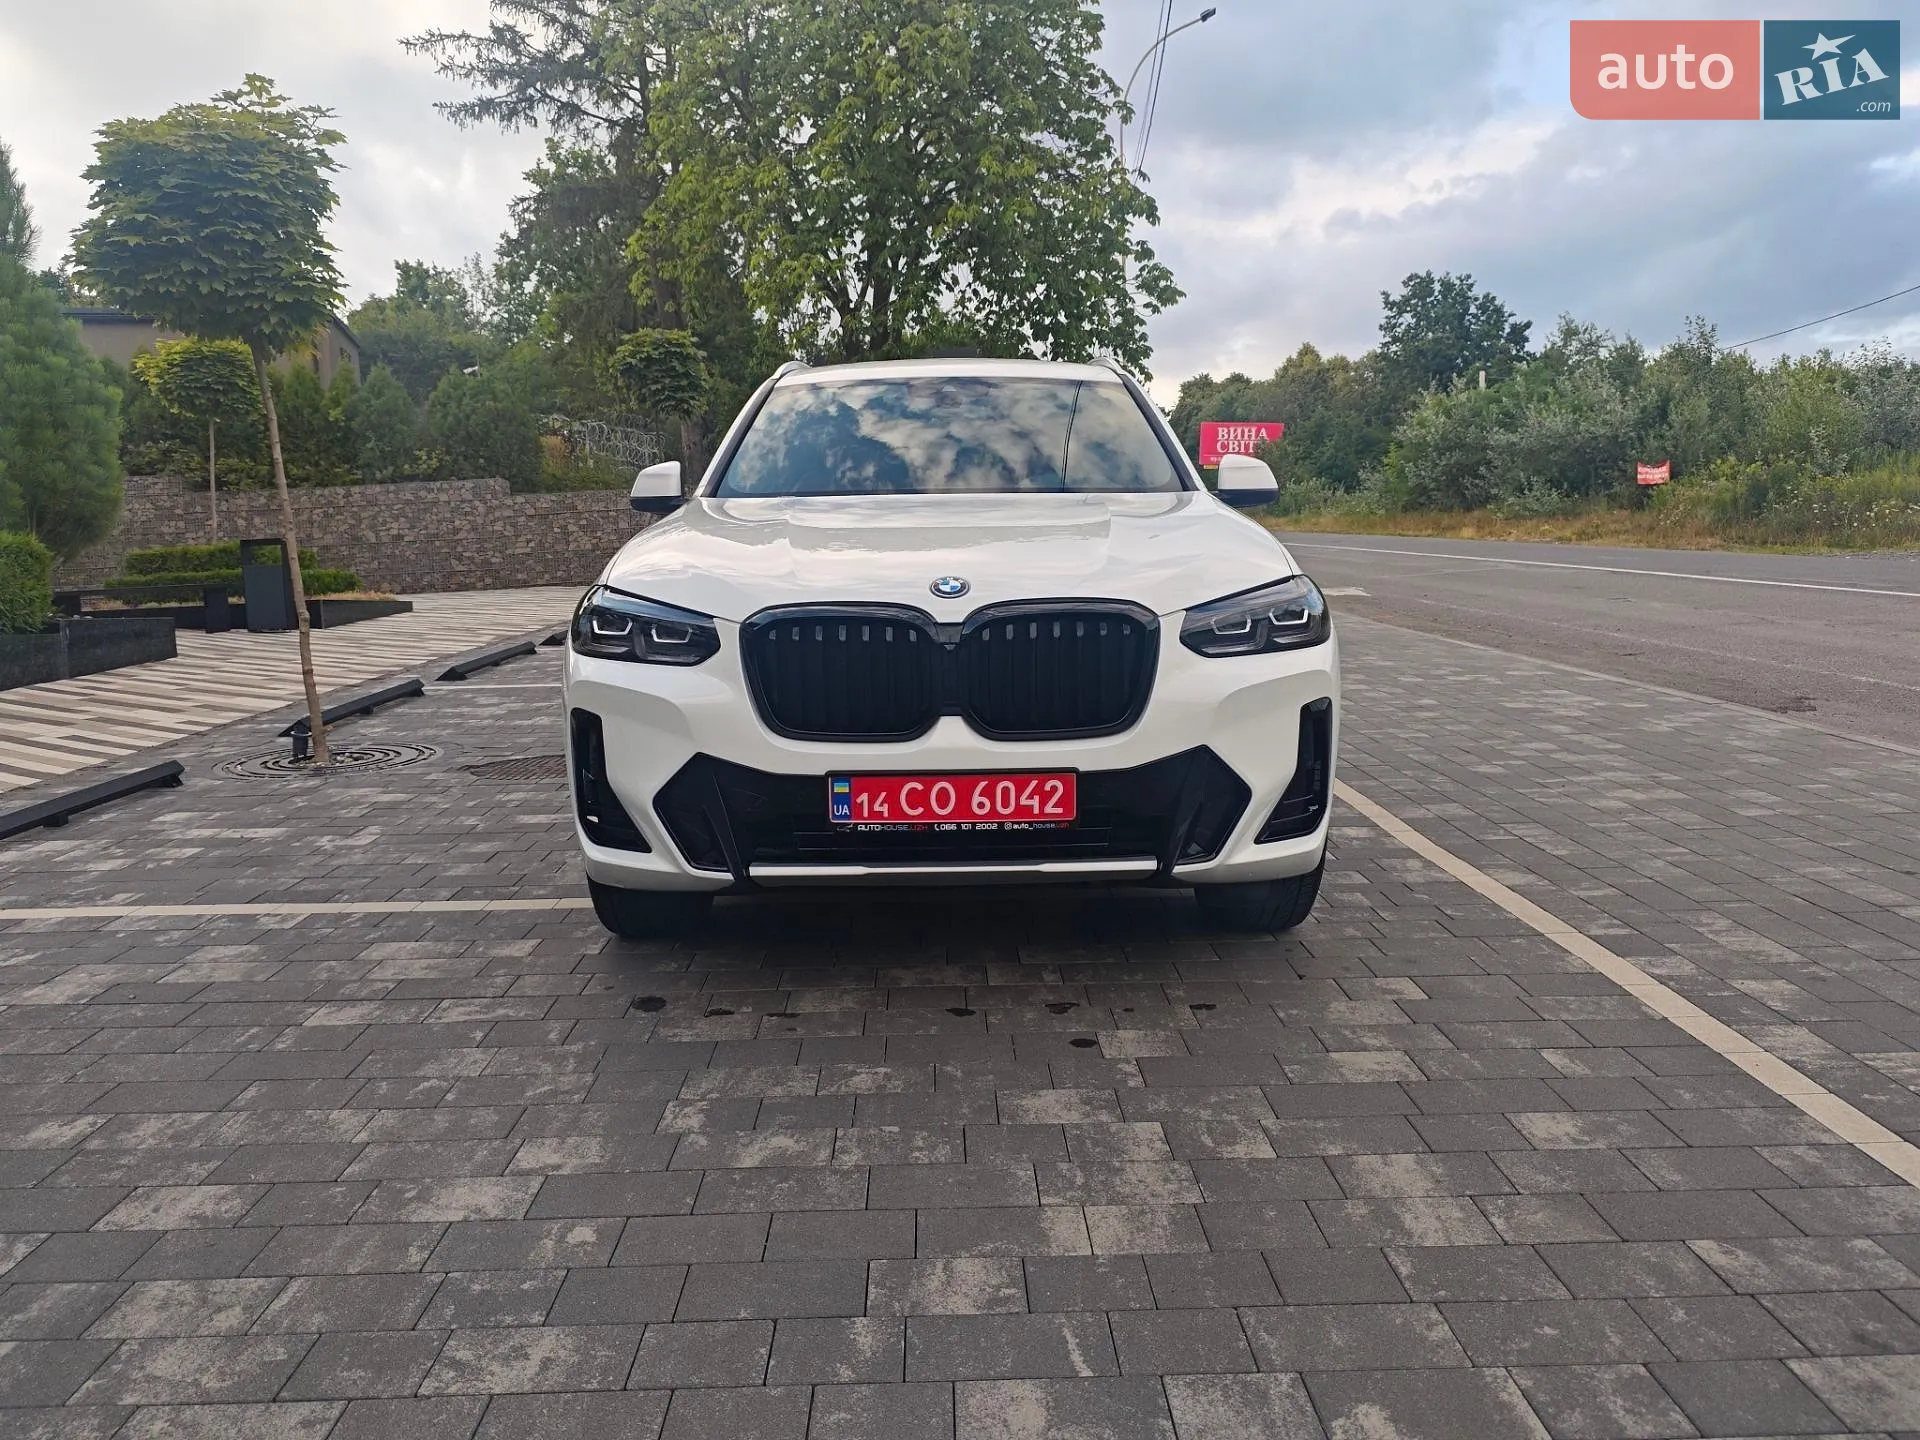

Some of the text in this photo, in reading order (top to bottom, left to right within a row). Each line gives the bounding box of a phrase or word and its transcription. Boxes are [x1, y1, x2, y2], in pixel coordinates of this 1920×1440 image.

[1217, 426, 1269, 442] ВИНА
[1216, 440, 1260, 453] СВІТ
[856, 779, 1064, 818] 14 CO 6042
[833, 804, 850, 816] UA
[939, 823, 957, 831] 066
[975, 822, 999, 830] 2002
